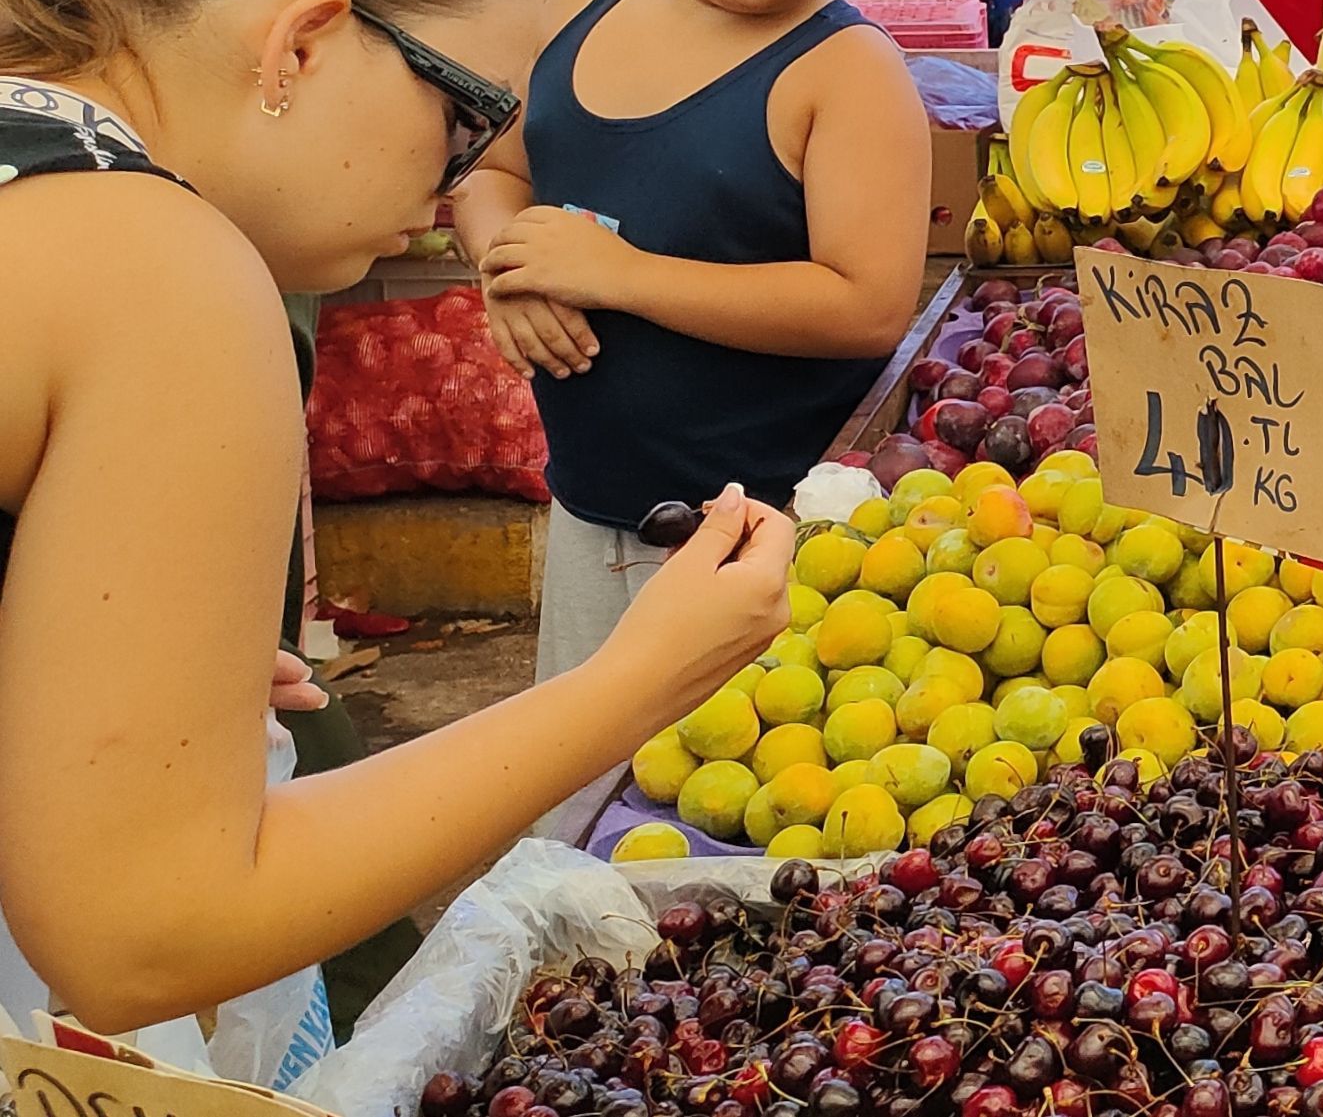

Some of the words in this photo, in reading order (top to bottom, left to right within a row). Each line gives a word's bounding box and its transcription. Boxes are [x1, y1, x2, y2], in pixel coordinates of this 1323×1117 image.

[1200, 344, 1305, 409] BAL
[1134, 391, 1235, 497] 40
[1254, 466, 1297, 512] KG
